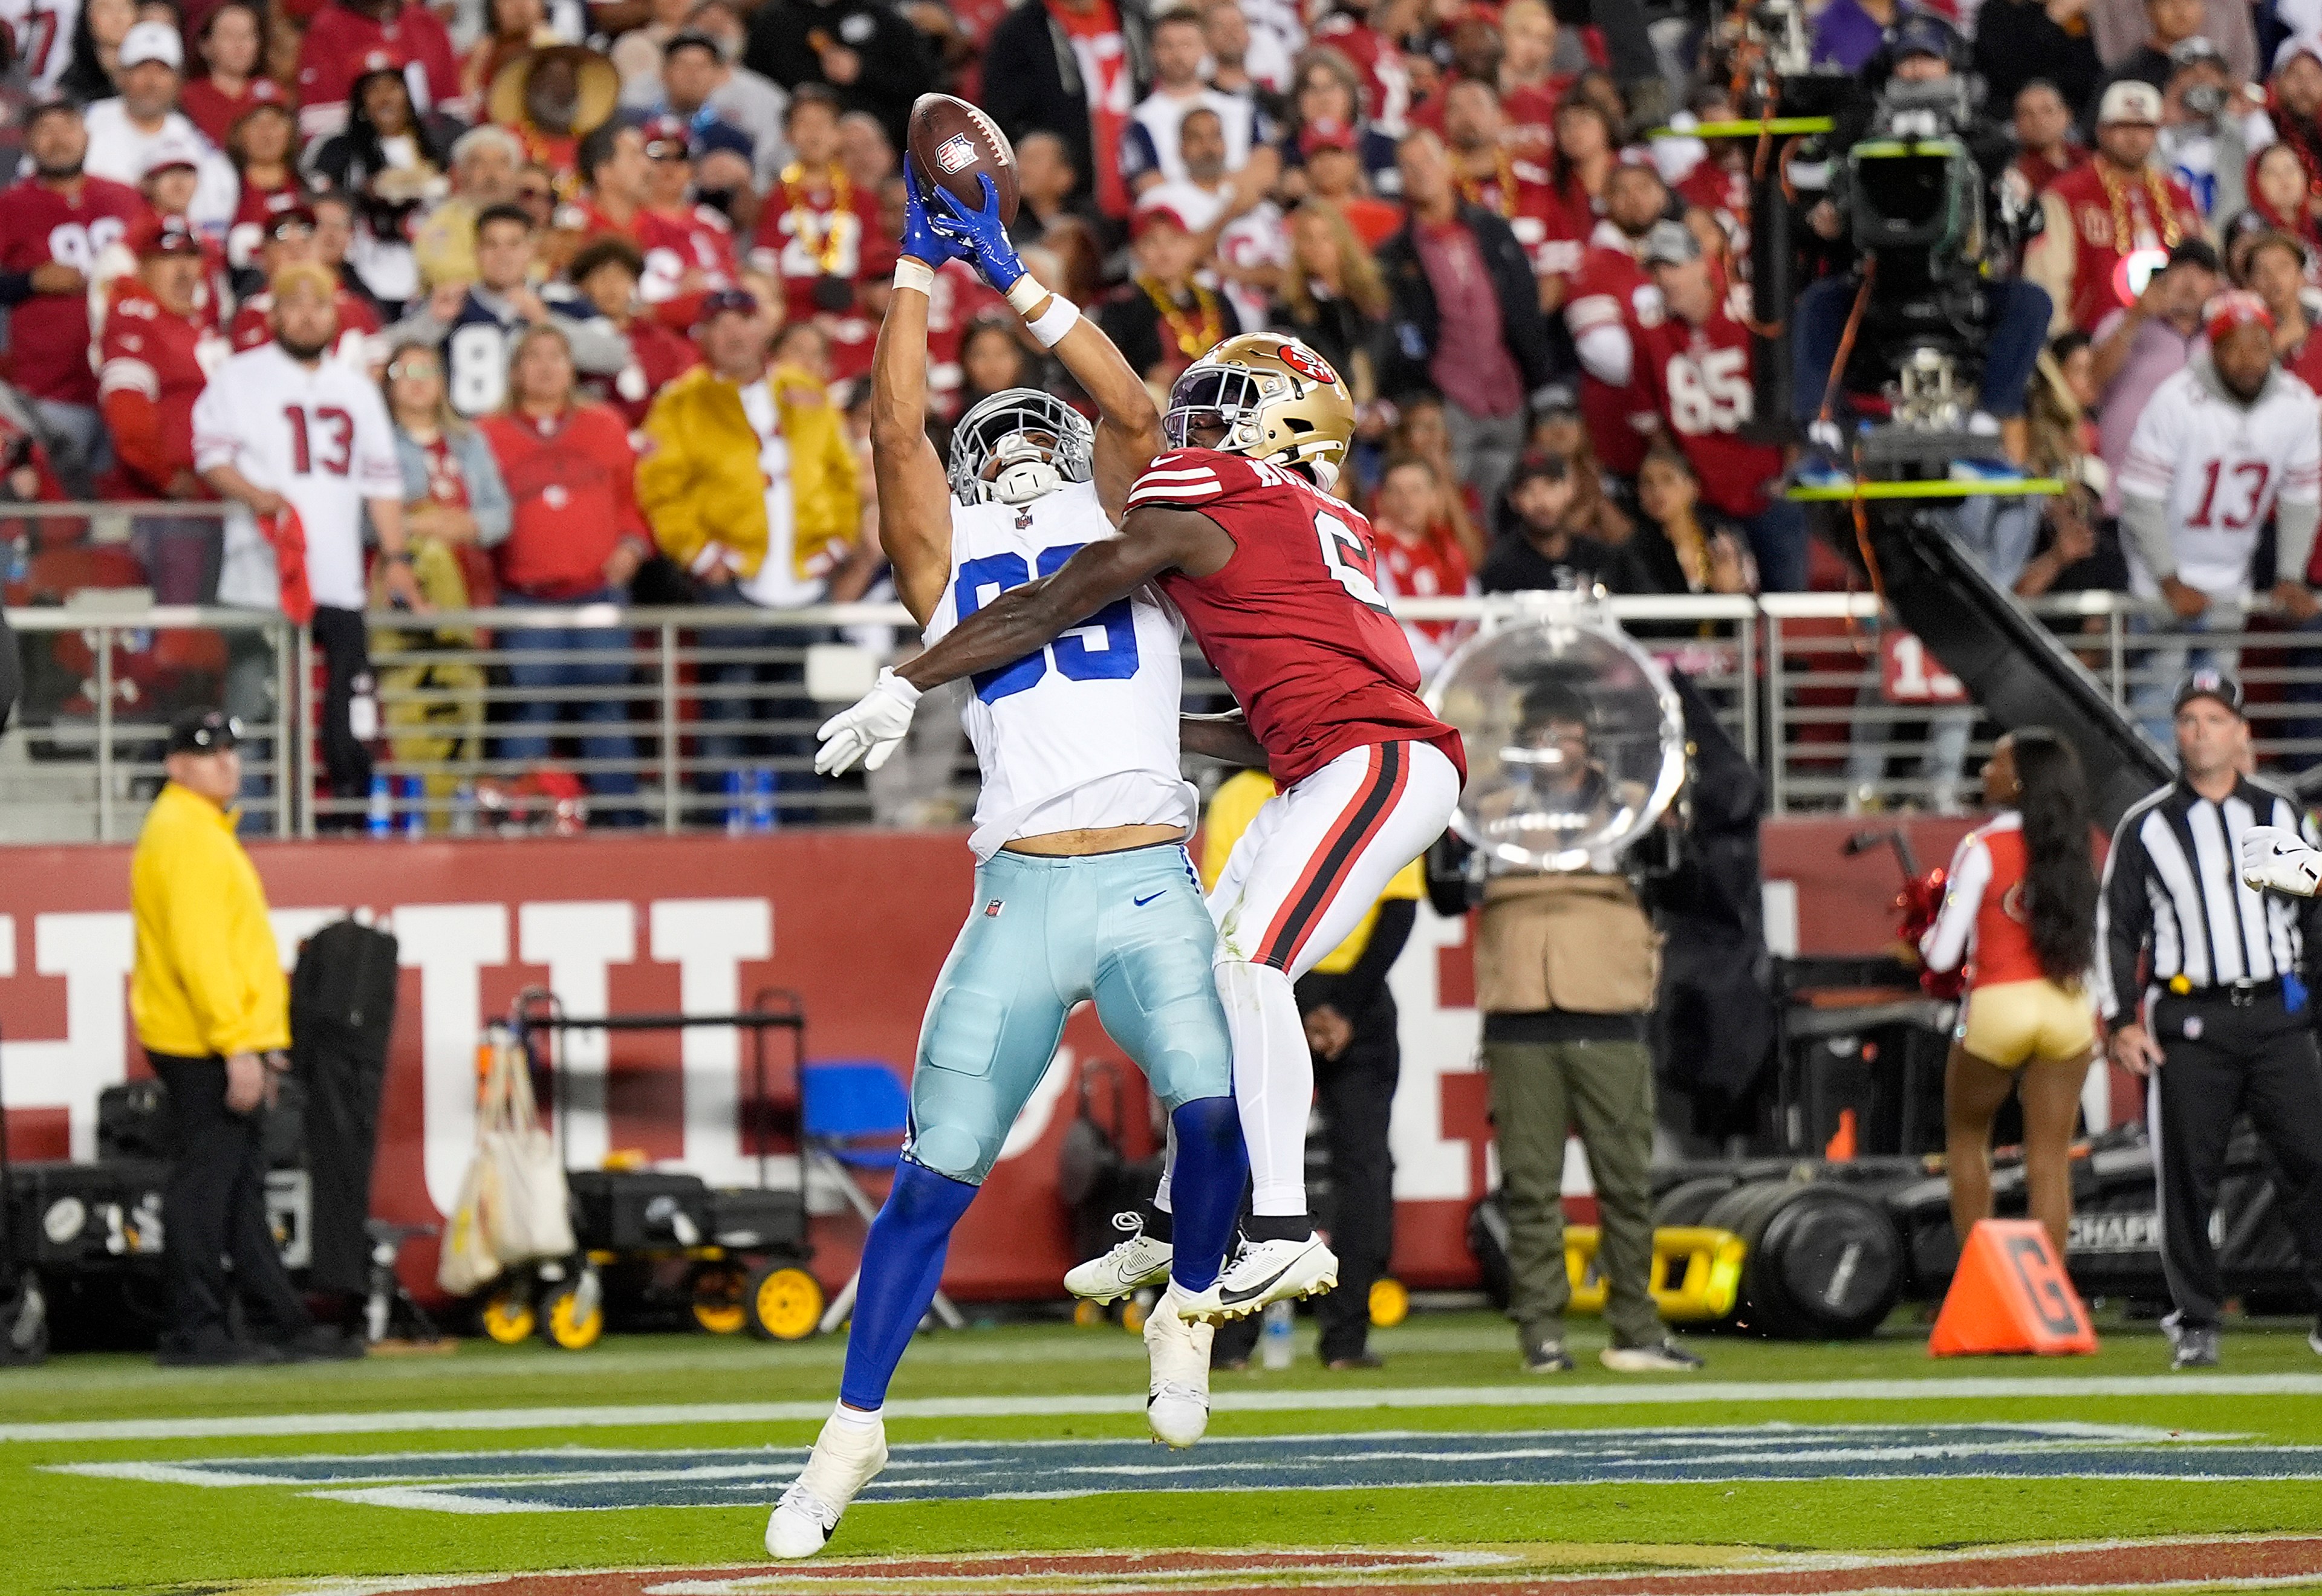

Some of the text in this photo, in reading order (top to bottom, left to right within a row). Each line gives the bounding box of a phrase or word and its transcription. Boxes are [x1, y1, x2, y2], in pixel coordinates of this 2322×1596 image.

[938, 143, 961, 170] NFL
[449, 320, 508, 414] 8
[1667, 346, 1754, 435] 85
[284, 405, 353, 475] 13
[2185, 458, 2270, 529] 13
[1892, 635, 1963, 697] 1
[2005, 1235, 2079, 1335] G
